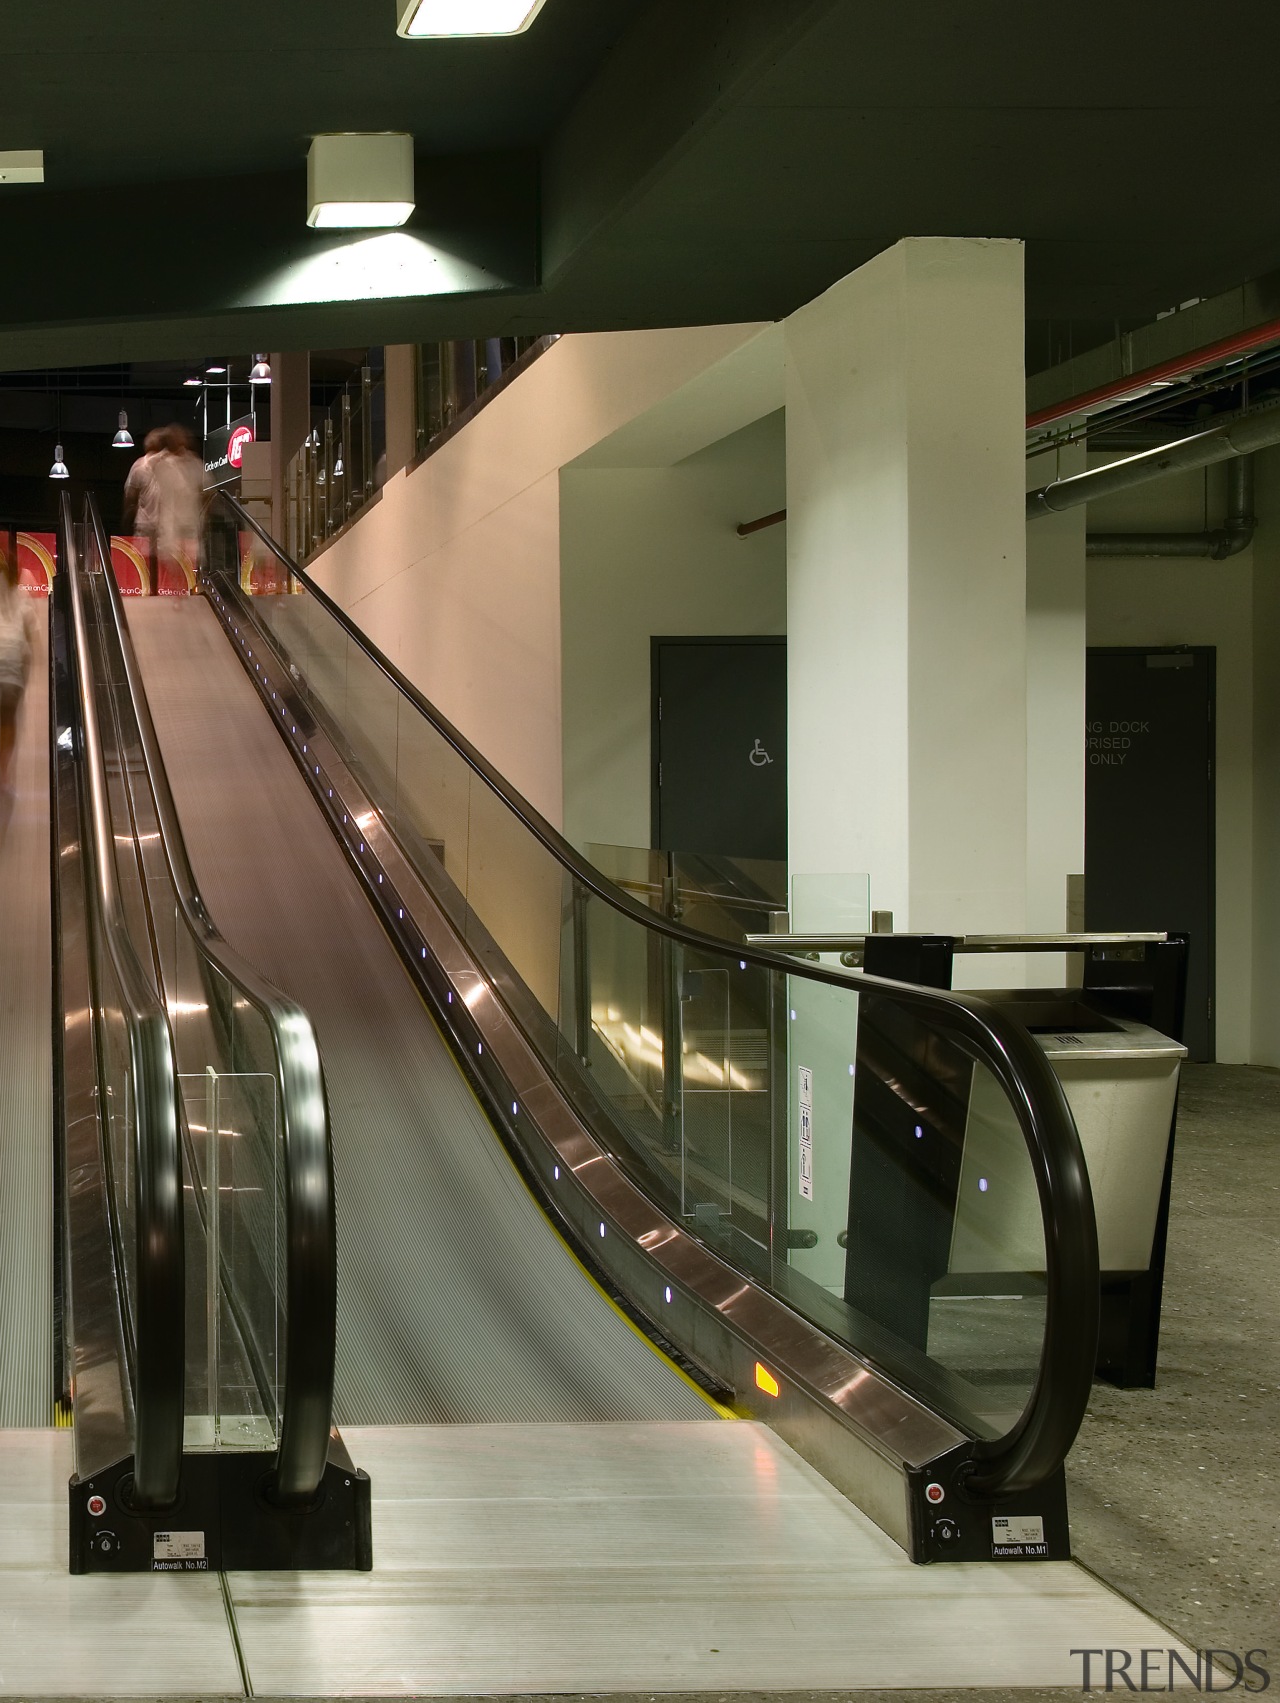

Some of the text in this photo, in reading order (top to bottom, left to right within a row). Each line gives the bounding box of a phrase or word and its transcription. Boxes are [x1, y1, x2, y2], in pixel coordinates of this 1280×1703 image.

[1110, 721, 1150, 733] DOCK
[1089, 753, 1127, 765] ONLY
[994, 1545, 1046, 1555] Autowalk No.M1
[153, 1560, 207, 1570] Autowalk No.M2
